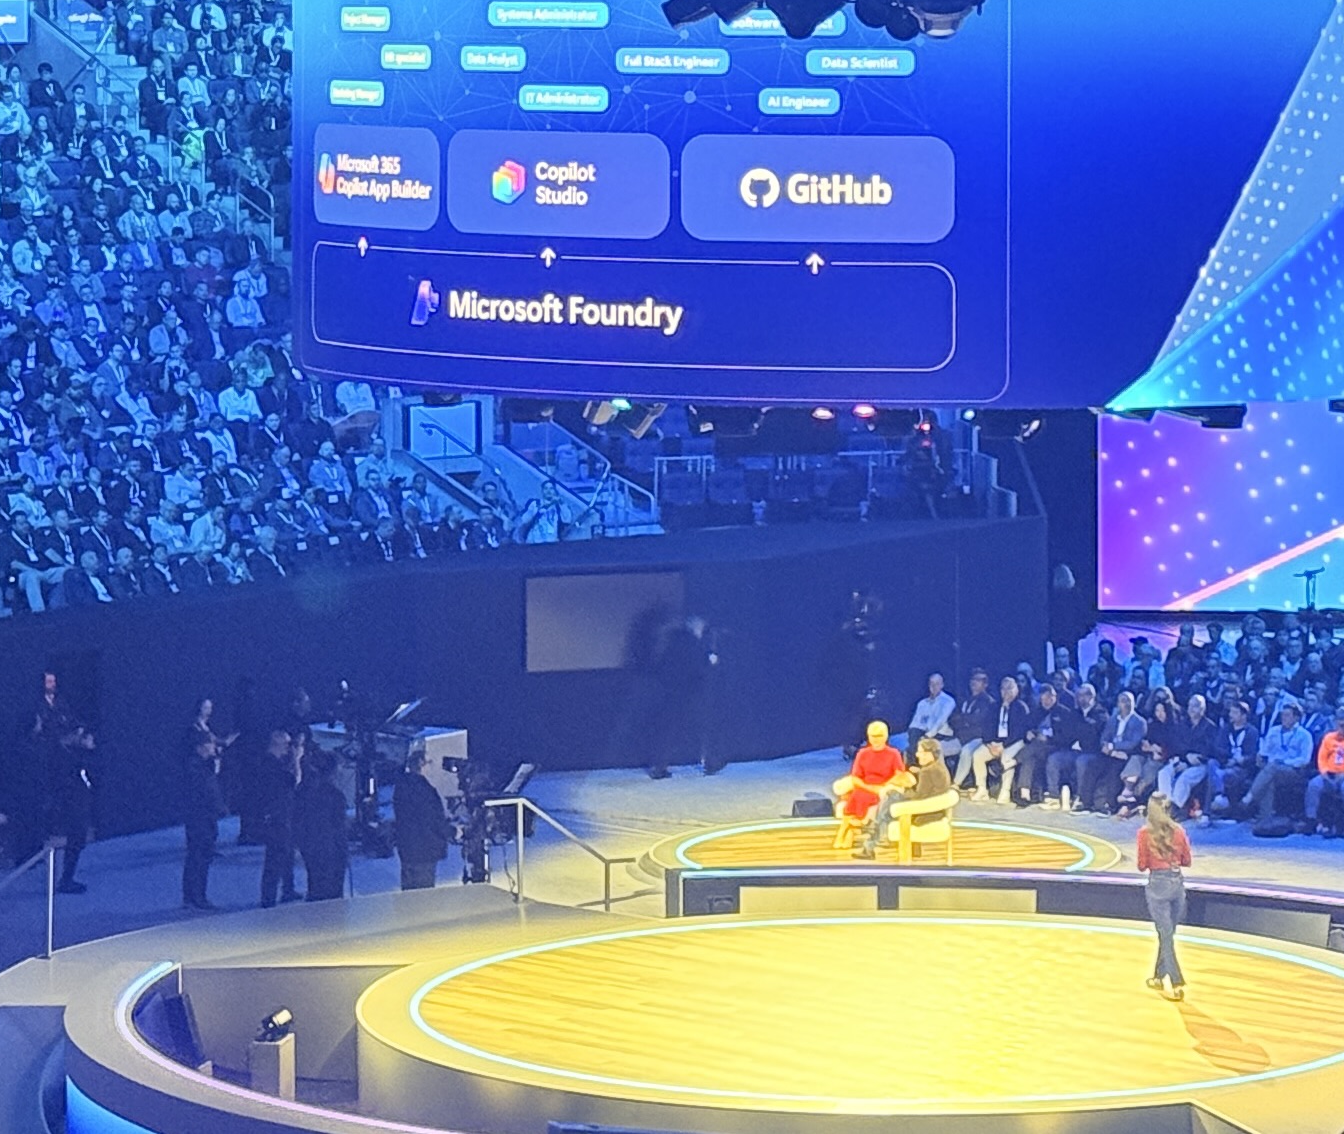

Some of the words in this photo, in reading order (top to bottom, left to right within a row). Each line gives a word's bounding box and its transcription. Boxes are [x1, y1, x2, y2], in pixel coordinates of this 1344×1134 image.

[623, 55, 643, 68] Full
[643, 55, 674, 68] Stack
[673, 55, 720, 71] Engineer
[821, 56, 849, 69] Data
[850, 56, 898, 69] Scientist
[767, 96, 782, 108] AI
[782, 96, 831, 112] Engineer
[336, 153, 380, 175] Microsoft
[379, 155, 401, 175] 365
[534, 161, 597, 185] Copilot
[336, 177, 369, 199] Copilot
[368, 178, 392, 203] App
[391, 179, 433, 200] Builder
[535, 185, 589, 206] Studio
[787, 172, 893, 205] GitHub
[449, 290, 564, 324] Microsoft
[568, 295, 684, 336] Foundry
